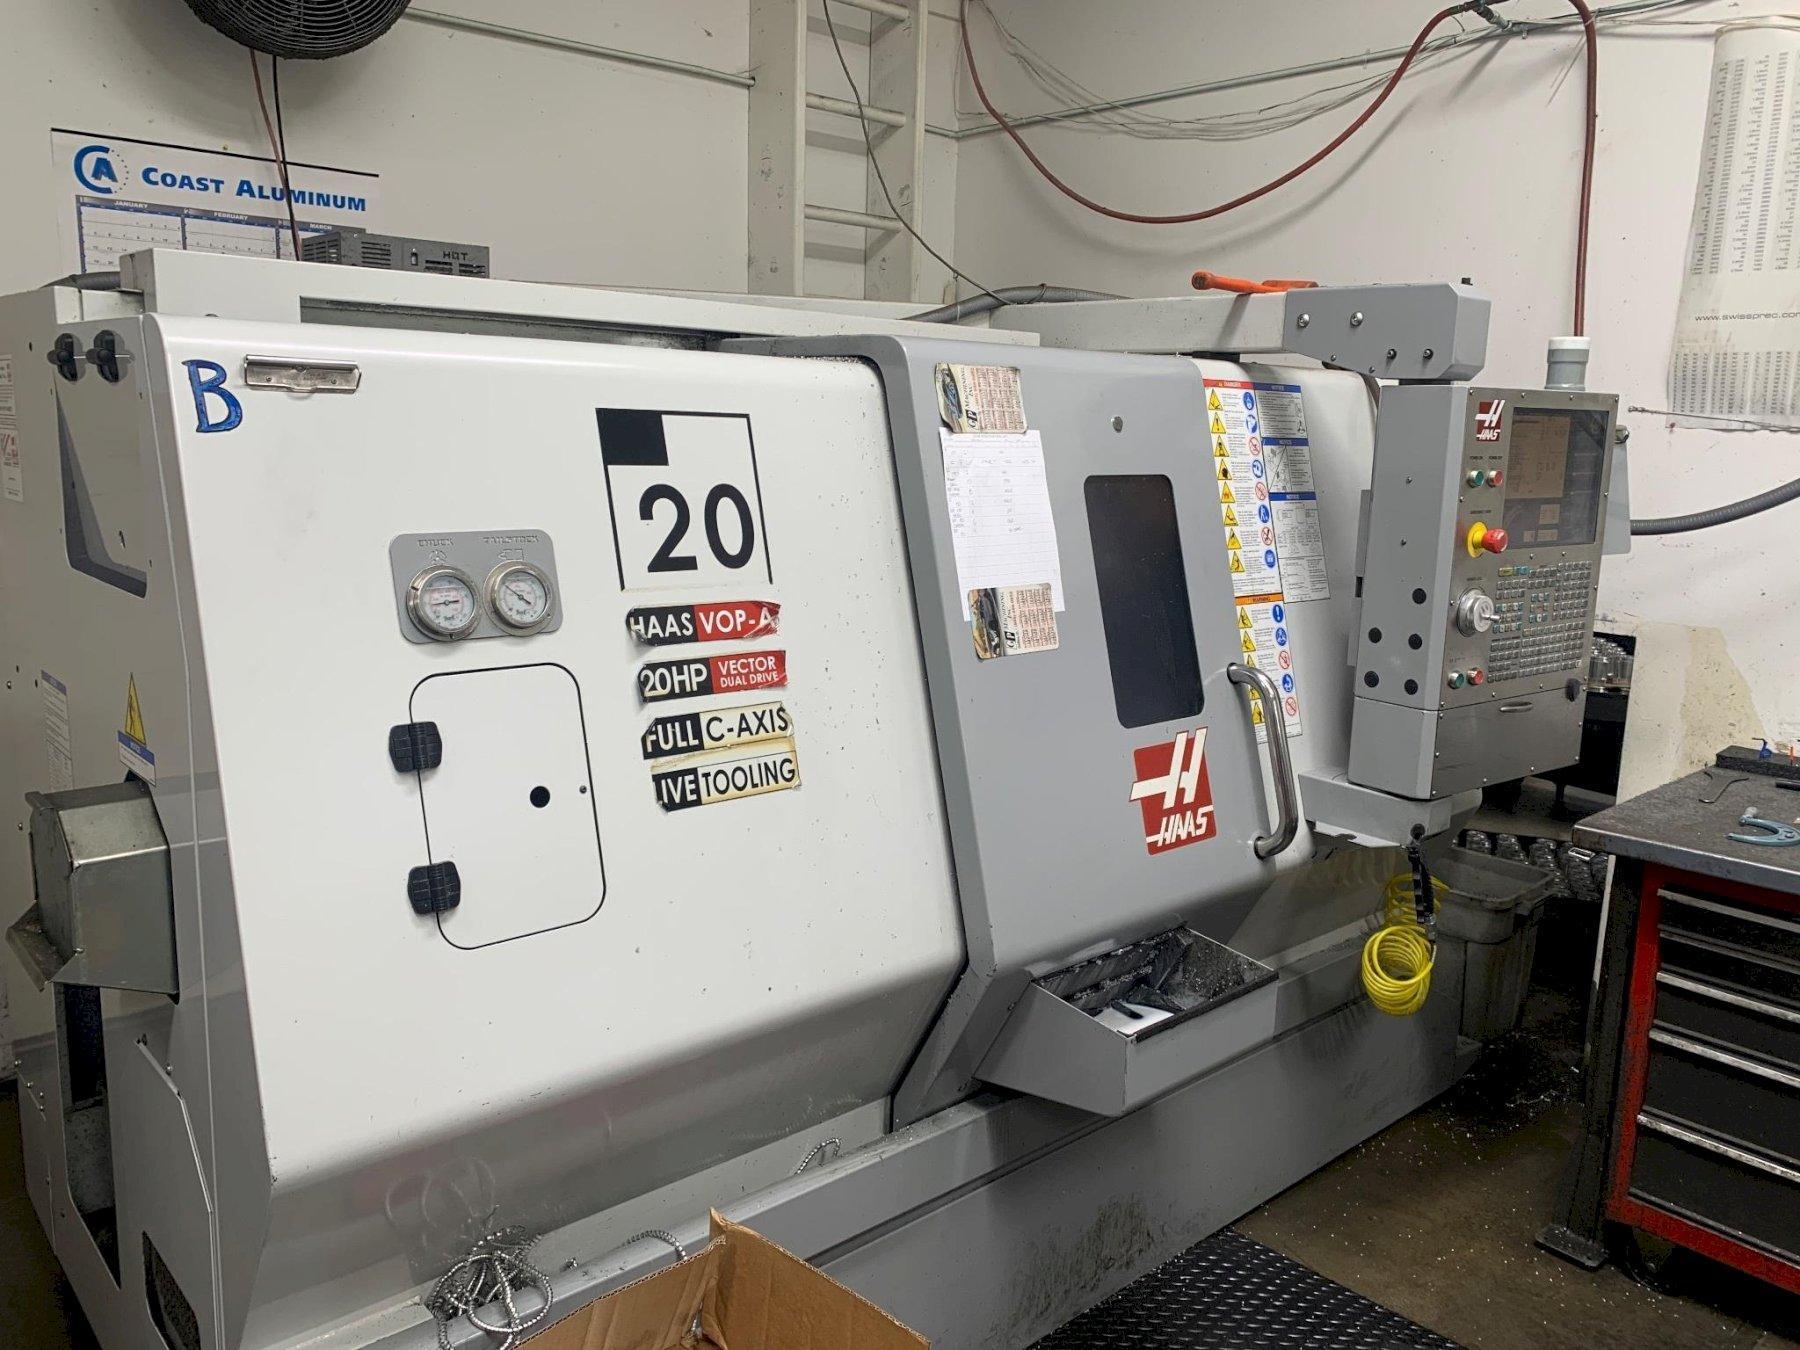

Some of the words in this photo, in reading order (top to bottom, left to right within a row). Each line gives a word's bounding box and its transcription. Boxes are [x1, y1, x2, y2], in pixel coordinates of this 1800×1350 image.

[114, 200, 148, 209] JANUARY
[213, 211, 248, 221] FEBRUARY
[309, 223, 333, 231] MARCH
[181, 359, 243, 433] B
[1476, 429, 1501, 441] HAAS
[639, 483, 755, 573] 20
[629, 612, 694, 639] HAAS
[640, 663, 708, 698] 20HP
[718, 655, 777, 676] VECTOR
[719, 676, 748, 688] DUAL
[750, 671, 779, 684] DRIVE
[645, 719, 700, 753] FULL
[706, 706, 789, 742] C-AXIS
[702, 757, 796, 798] TOOLING
[1145, 804, 1215, 847] HAAS
